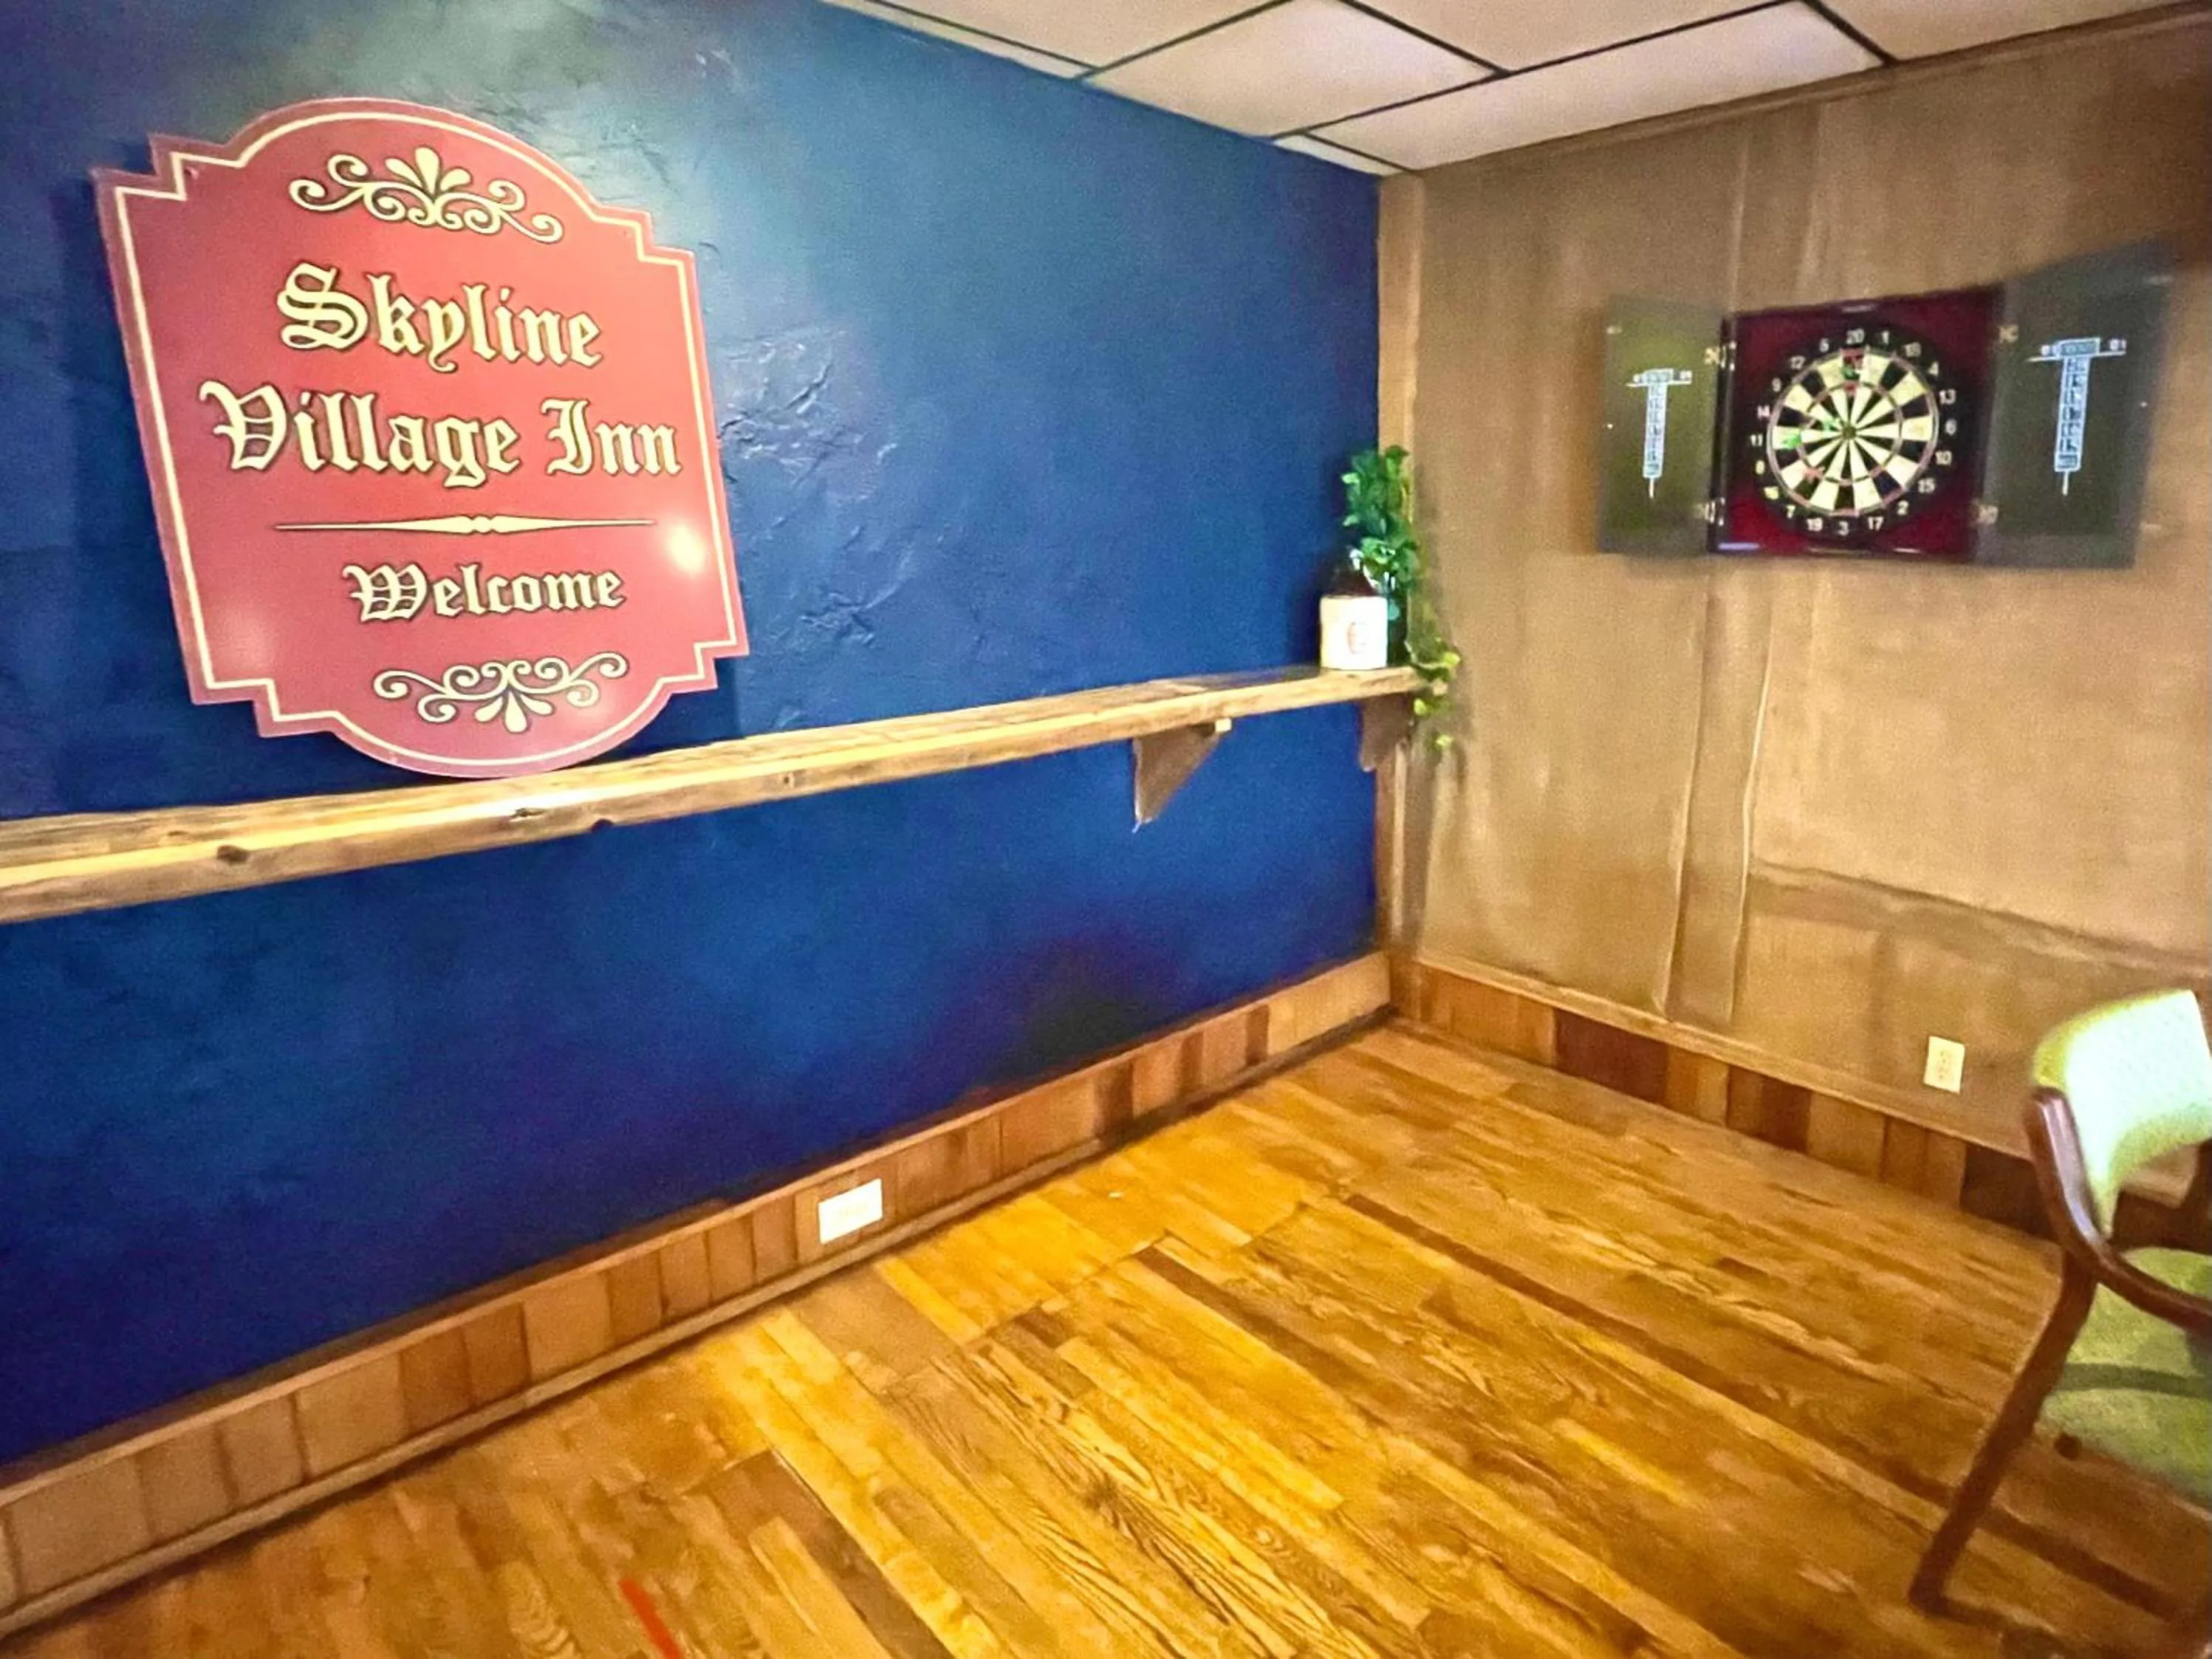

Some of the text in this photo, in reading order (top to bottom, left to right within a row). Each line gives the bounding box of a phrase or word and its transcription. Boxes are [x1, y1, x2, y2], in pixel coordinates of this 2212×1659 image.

[277, 262, 603, 373] Skyline
[1846, 328, 1865, 345] 20
[1881, 330, 1891, 344] 1
[1820, 338, 1829, 352] 5
[1928, 360, 1939, 376] 4
[1939, 389, 1956, 405] 13
[1757, 405, 1770, 420] 14
[199, 380, 682, 488] Village Inn
[1945, 419, 1957, 435] 6
[1749, 434, 1763, 446] 11
[1935, 450, 1952, 466] 10
[1786, 504, 1796, 519] 7
[1897, 500, 1908, 516] 2
[1838, 520, 1849, 536] 3
[1867, 516, 1884, 530] 17
[343, 564, 624, 623] Welcome
